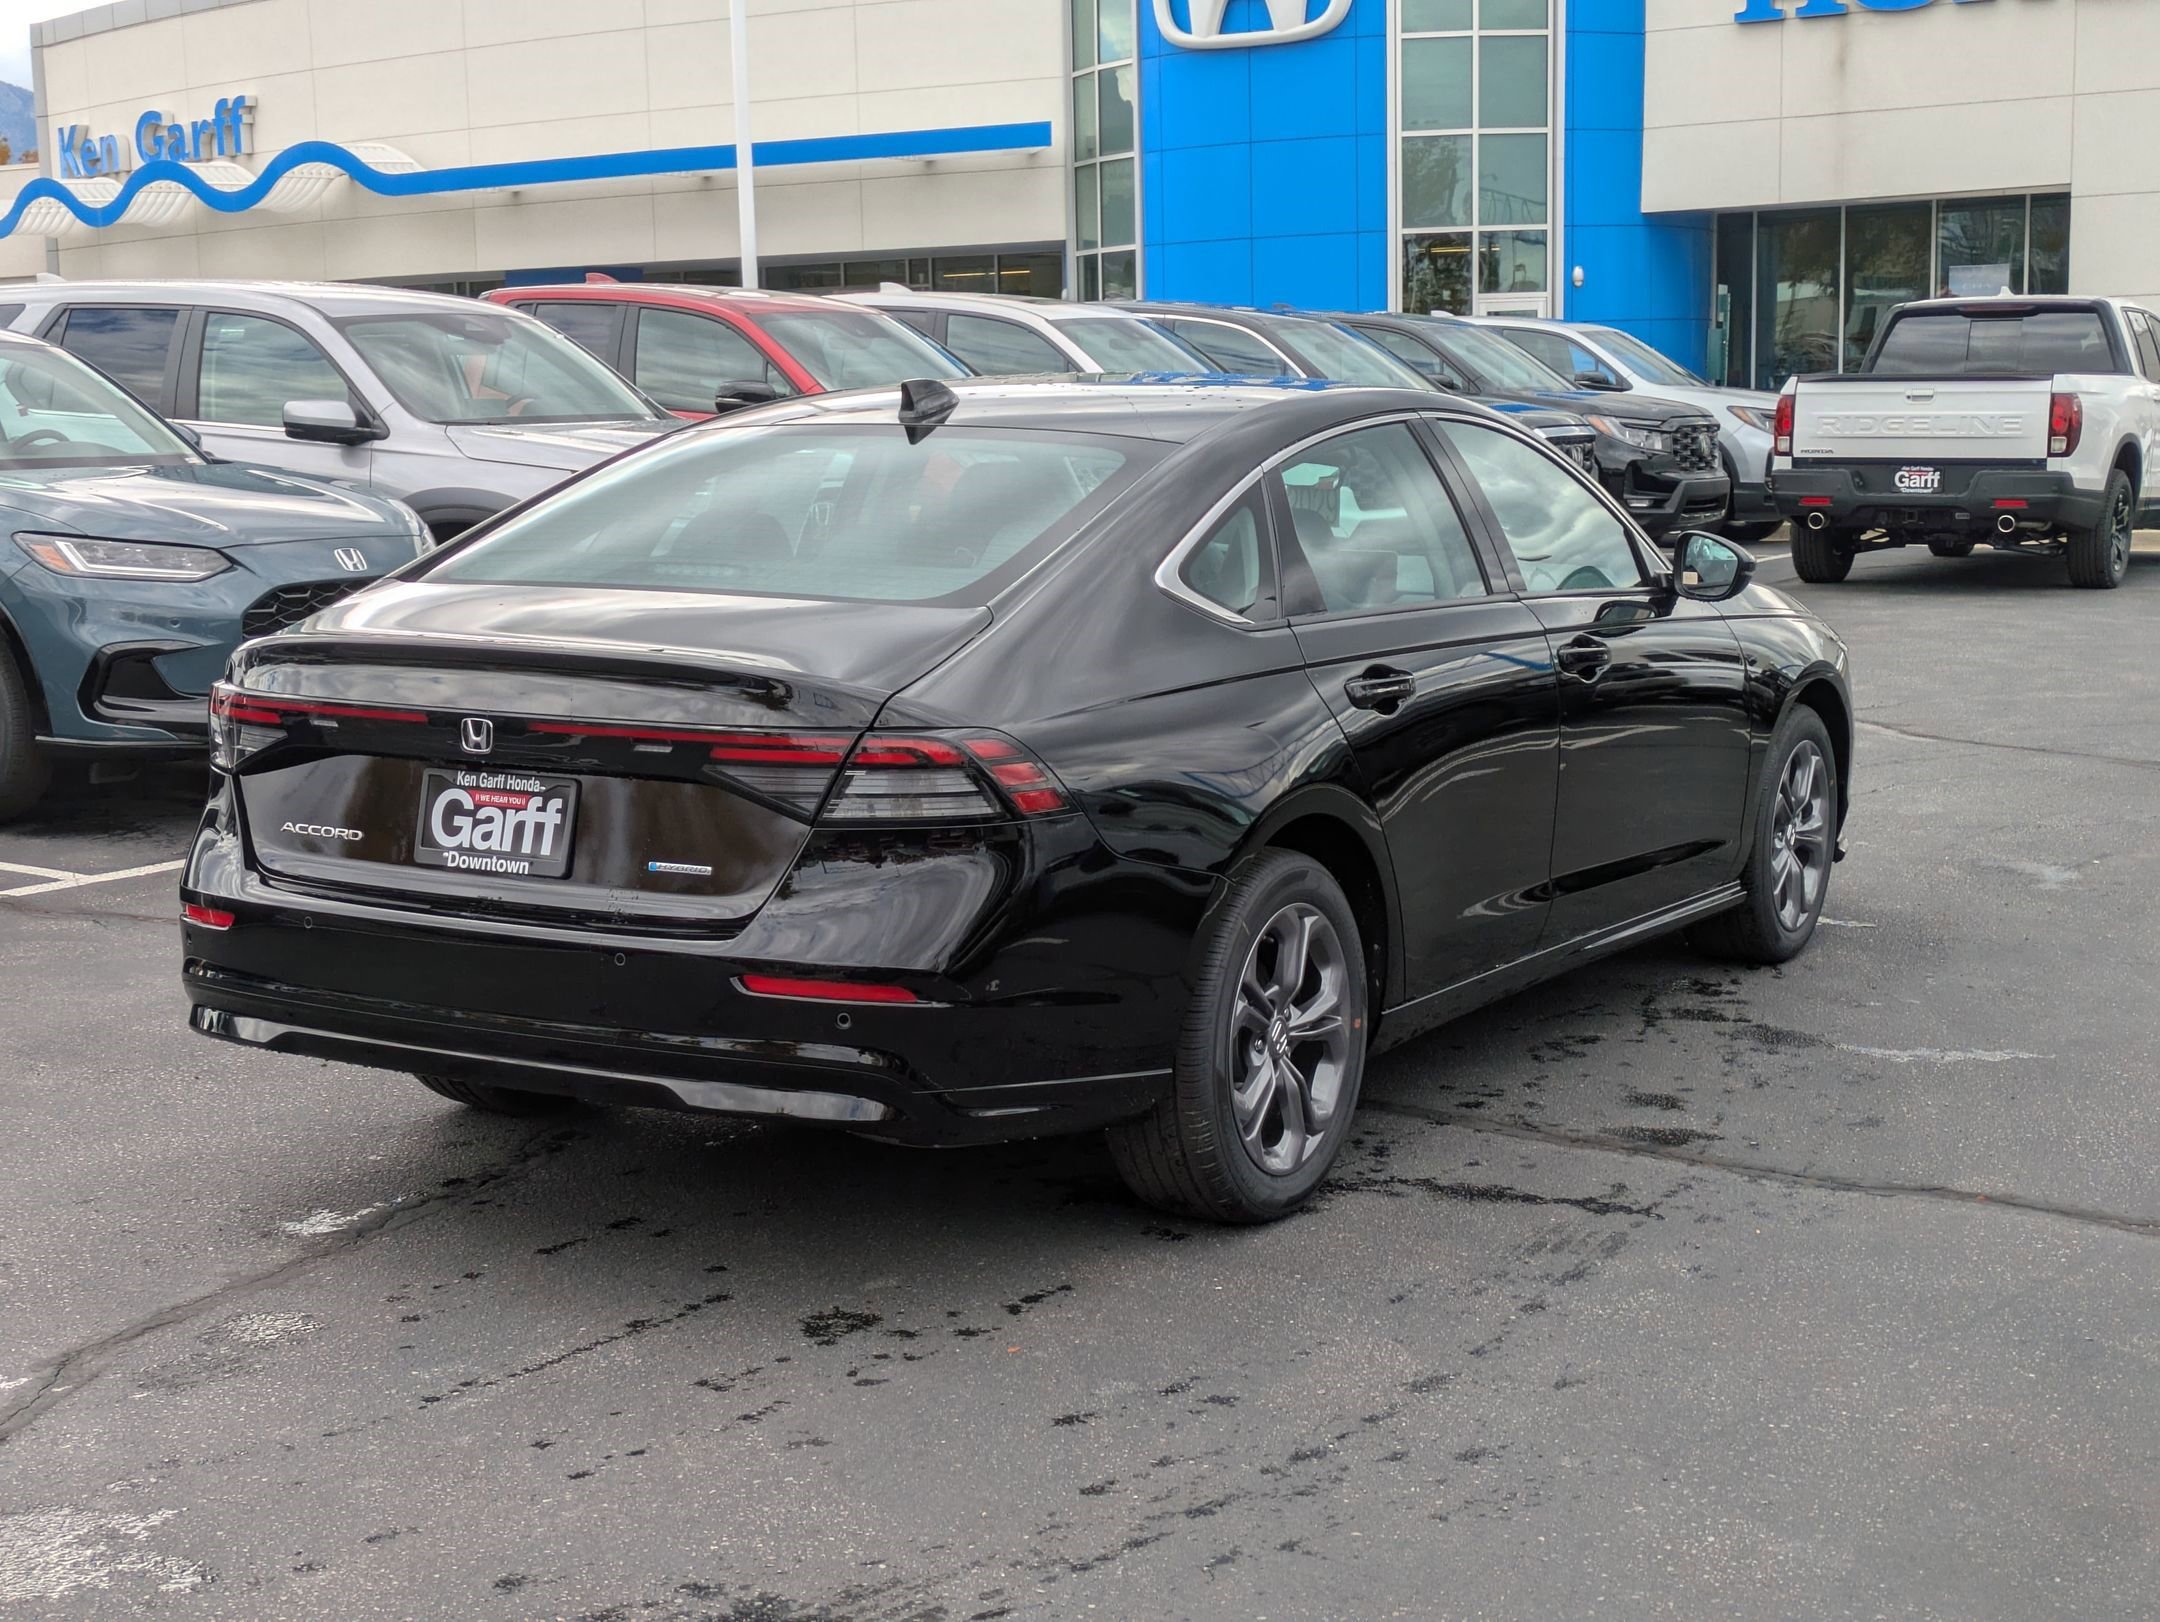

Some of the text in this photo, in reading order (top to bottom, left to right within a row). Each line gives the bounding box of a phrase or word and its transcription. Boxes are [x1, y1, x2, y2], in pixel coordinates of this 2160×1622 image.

[57, 95, 252, 178] Ken Garff
[1818, 417, 2023, 435] RIDGELINE
[1894, 470, 1941, 488] Garff
[456, 770, 540, 792] Ken Garff Honda
[480, 794, 522, 805] WE HEAR YOU
[280, 821, 364, 841] ACCORD
[431, 788, 563, 856] Garff
[447, 850, 530, 874] Downtown
[657, 864, 708, 874] HYBRID
